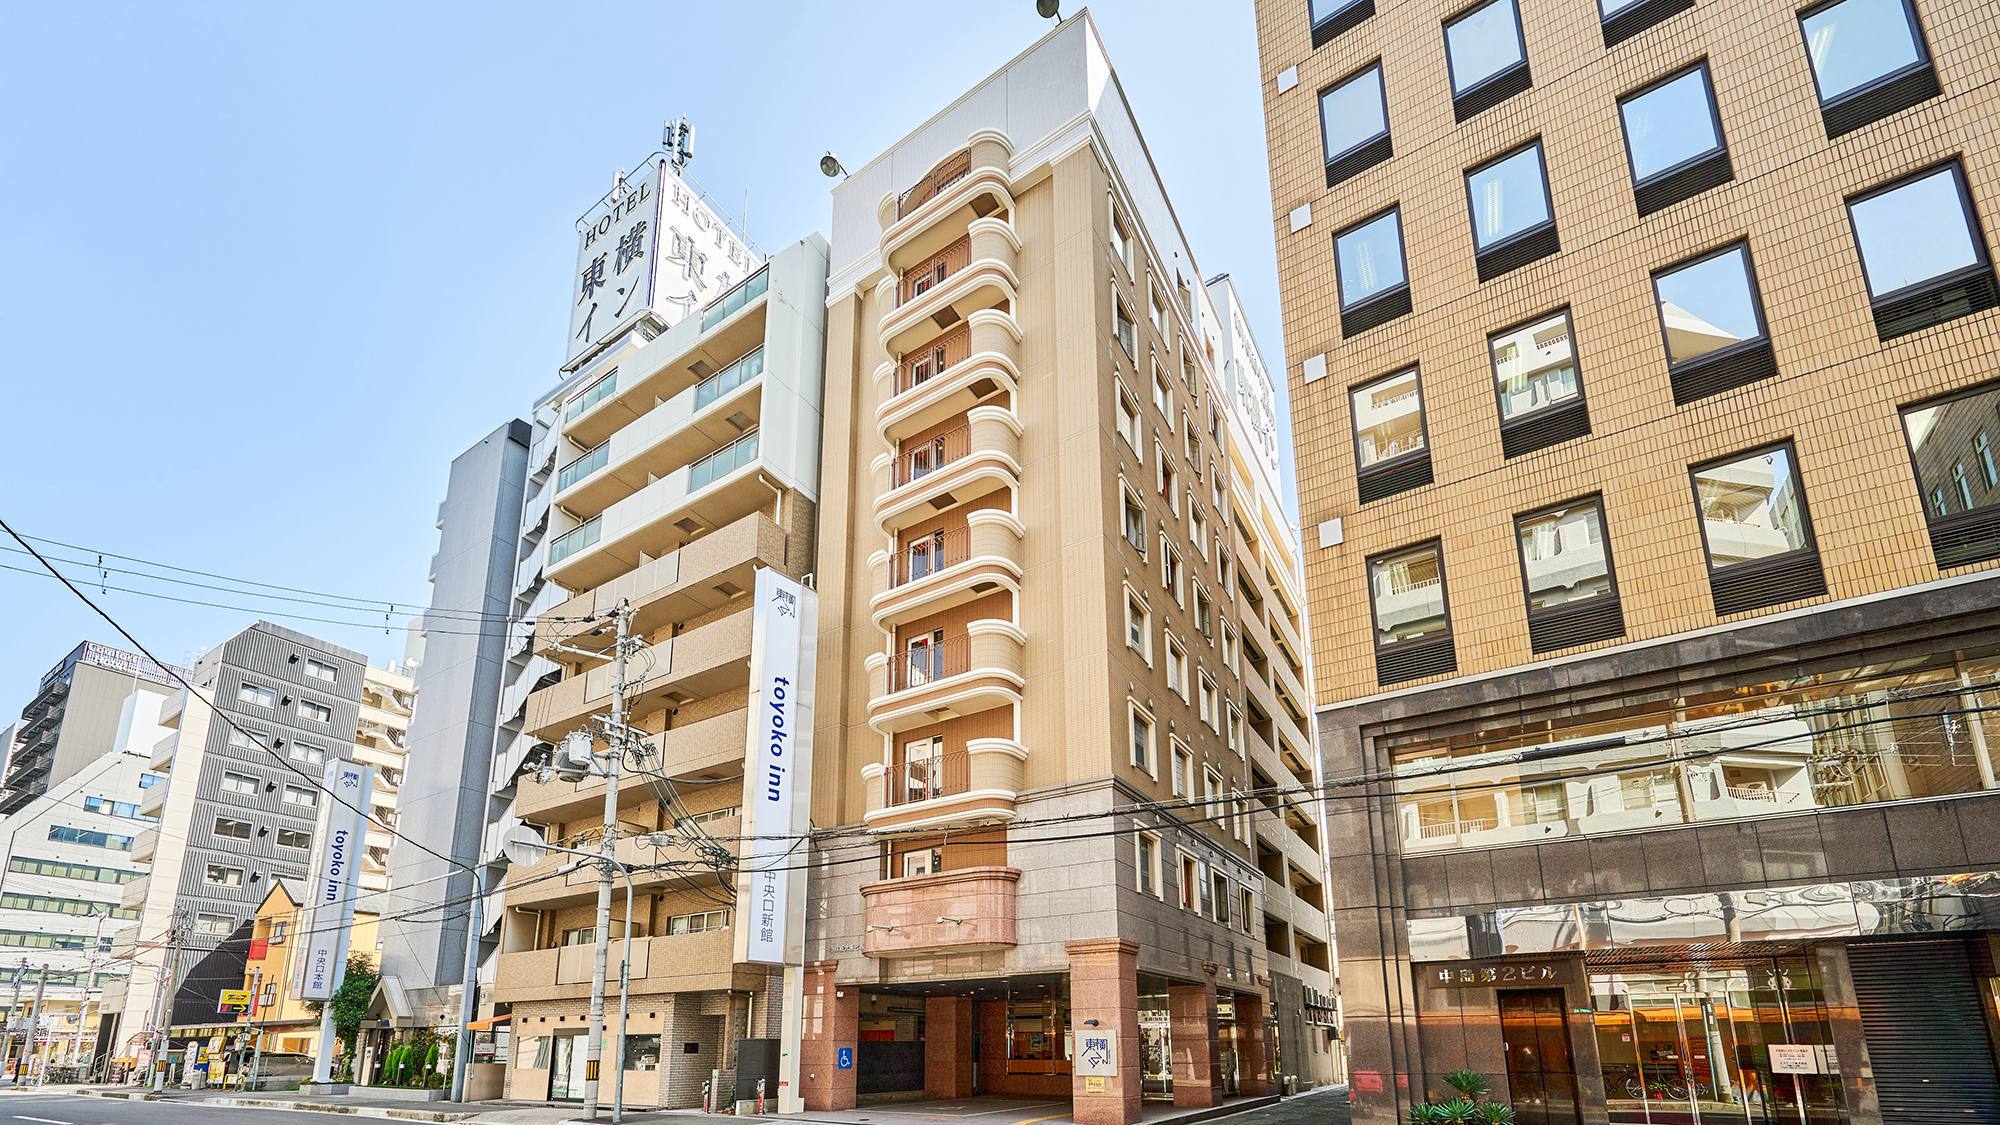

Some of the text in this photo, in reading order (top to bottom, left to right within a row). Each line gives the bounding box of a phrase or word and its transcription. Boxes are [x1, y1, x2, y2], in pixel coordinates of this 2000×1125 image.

[584, 182, 651, 251] HOTEL
[767, 676, 790, 802] toyoko inn
[326, 830, 348, 901] toyoko inn
[760, 869, 777, 943] 中央口新館
[312, 949, 327, 990] 中央口本館
